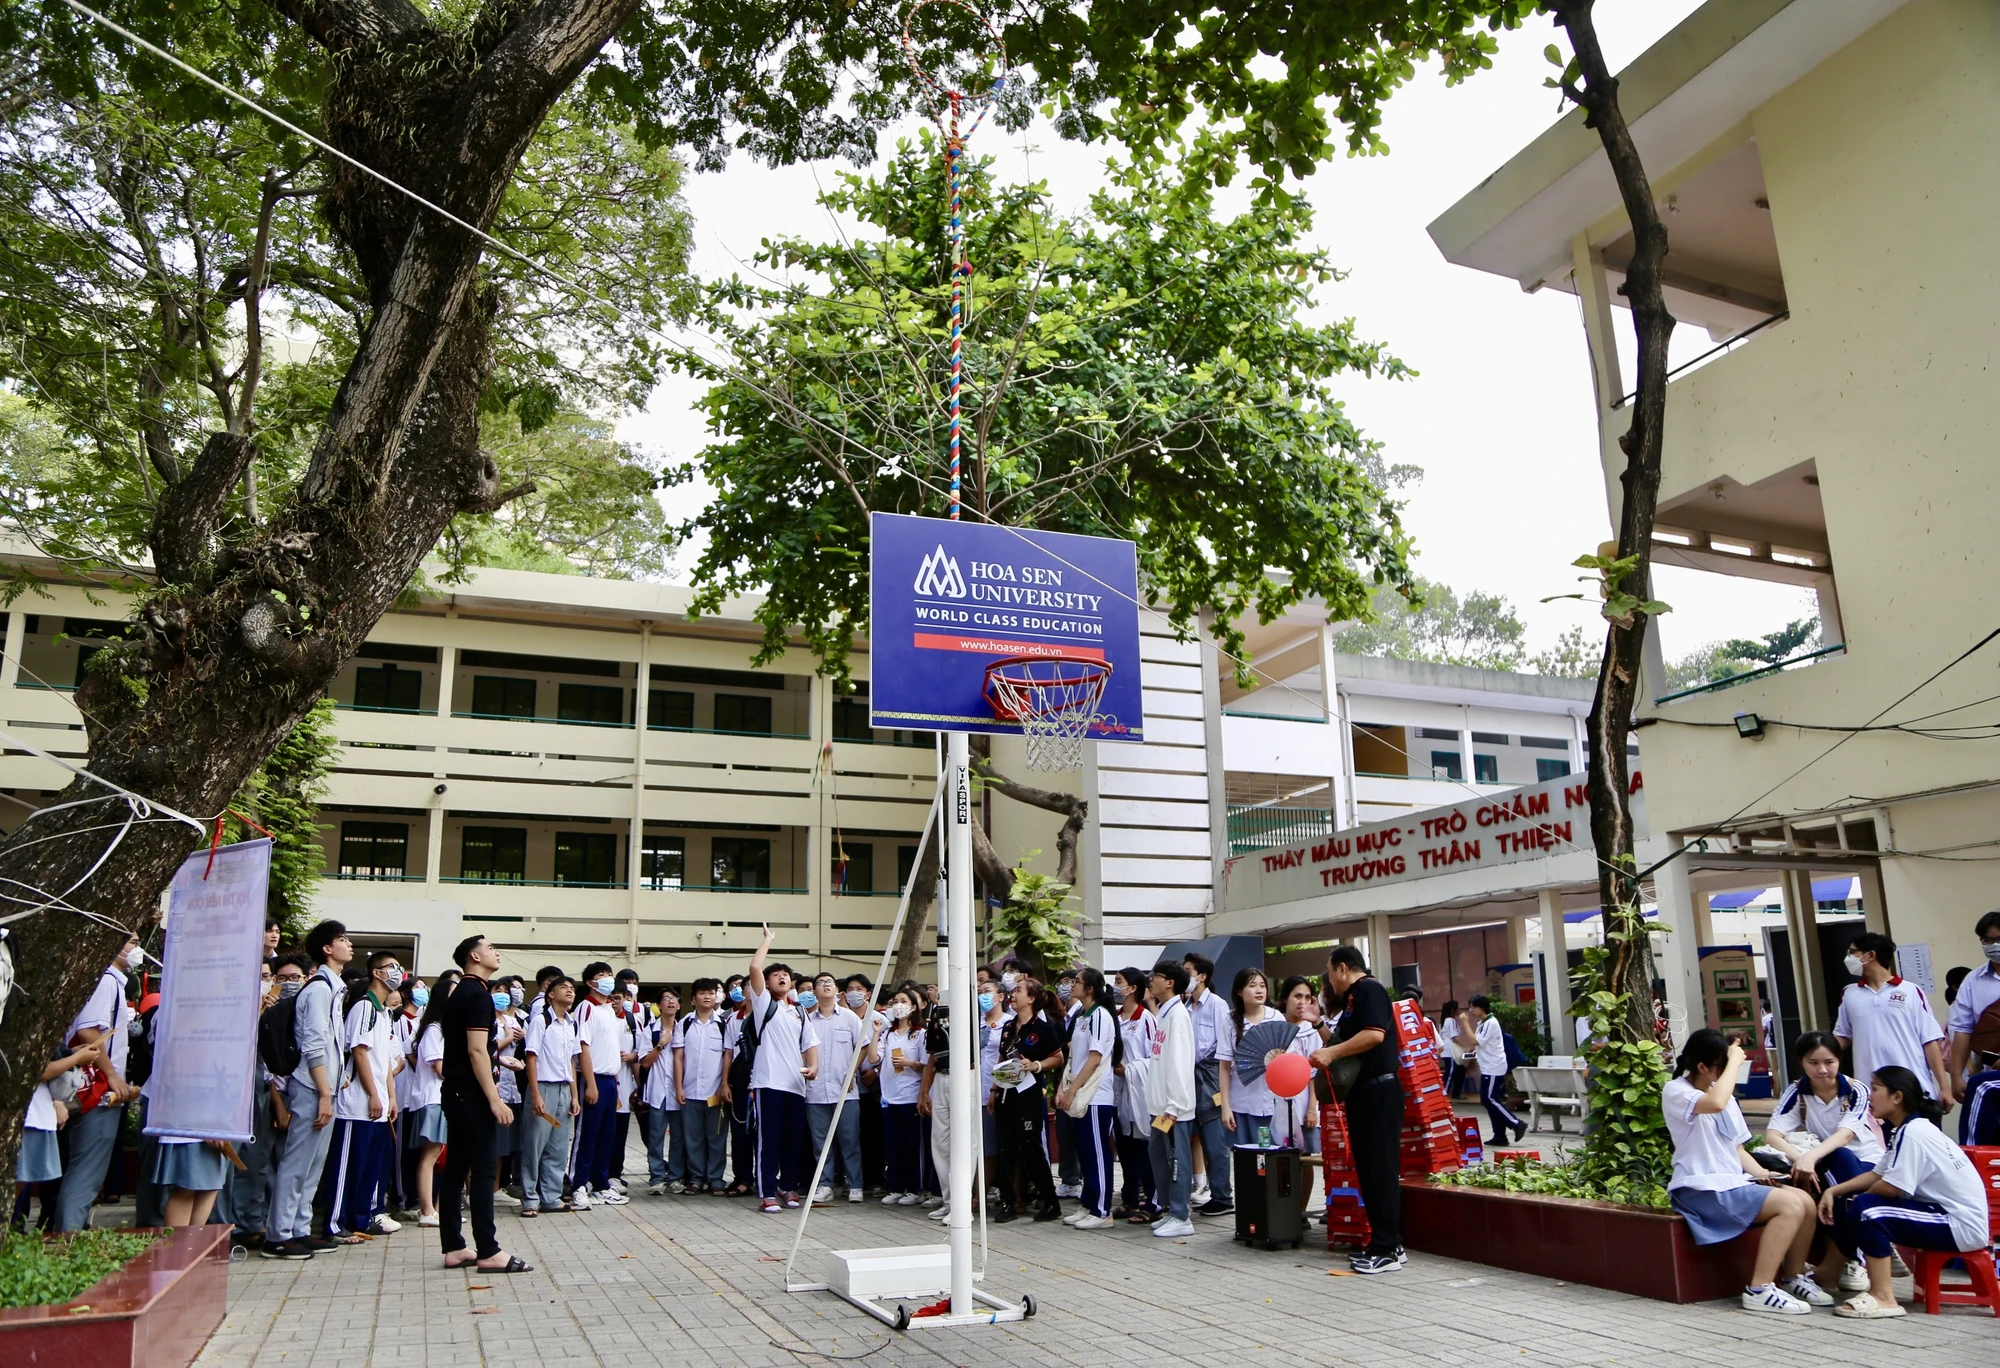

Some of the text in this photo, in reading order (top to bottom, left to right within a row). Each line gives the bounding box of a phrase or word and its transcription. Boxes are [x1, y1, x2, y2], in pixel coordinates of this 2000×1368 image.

[970, 561, 1063, 587] HOA SEN
[970, 583, 1102, 612] UNIVERSITY
[915, 607, 1102, 635] WORLD CLASS EDUCATION
[960, 640, 1063, 656] www.hoasen.edu.vn
[1356, 827, 1402, 855] MỰC
[1420, 808, 1467, 839] TRÒ
[1476, 793, 1549, 826] CHĂM
[1320, 820, 1573, 887] TRƯỜNG THÂN THIỆN
